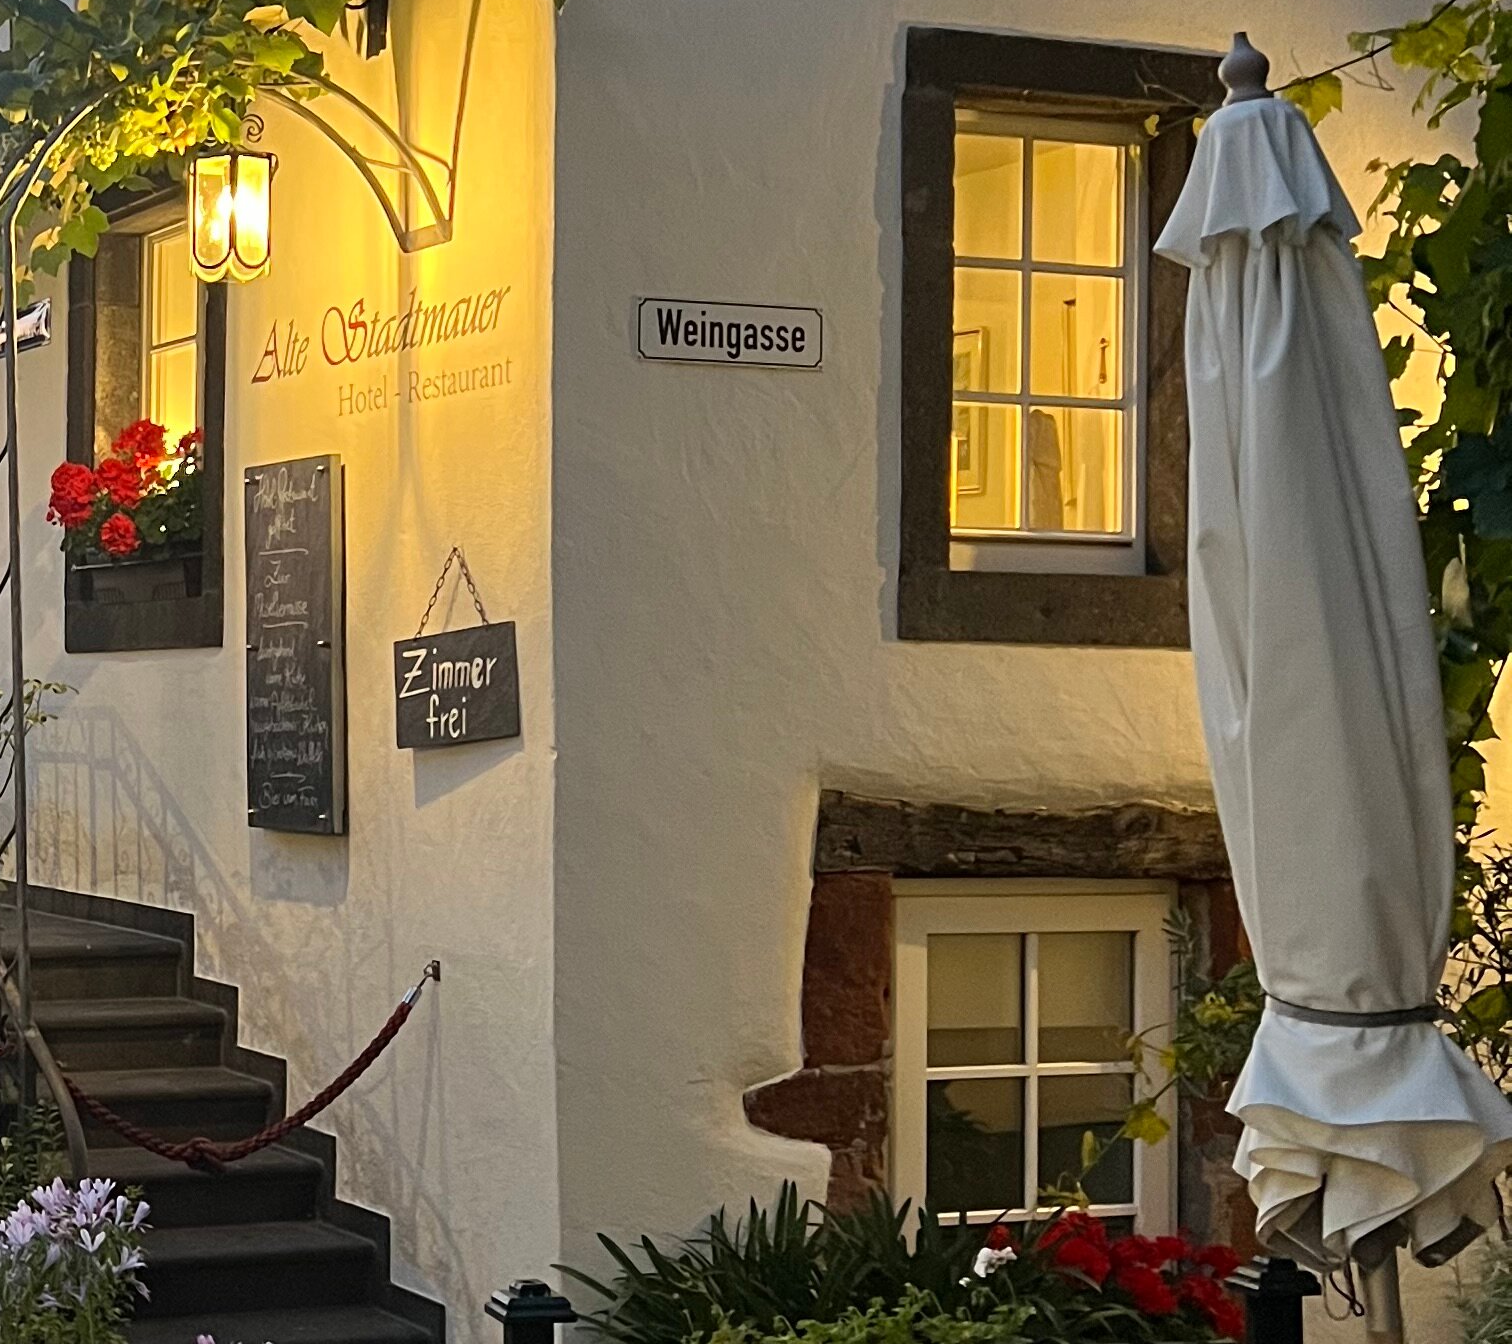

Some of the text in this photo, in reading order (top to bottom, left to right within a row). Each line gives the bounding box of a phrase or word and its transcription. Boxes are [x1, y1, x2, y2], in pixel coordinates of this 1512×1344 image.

[251, 286, 511, 384] Alte Stadtmauer
[656, 308, 806, 359] Weingasse
[338, 375, 388, 416] Hotel
[408, 357, 512, 404] Restaurant
[399, 648, 497, 698] Zimmer
[426, 694, 466, 739] frei
